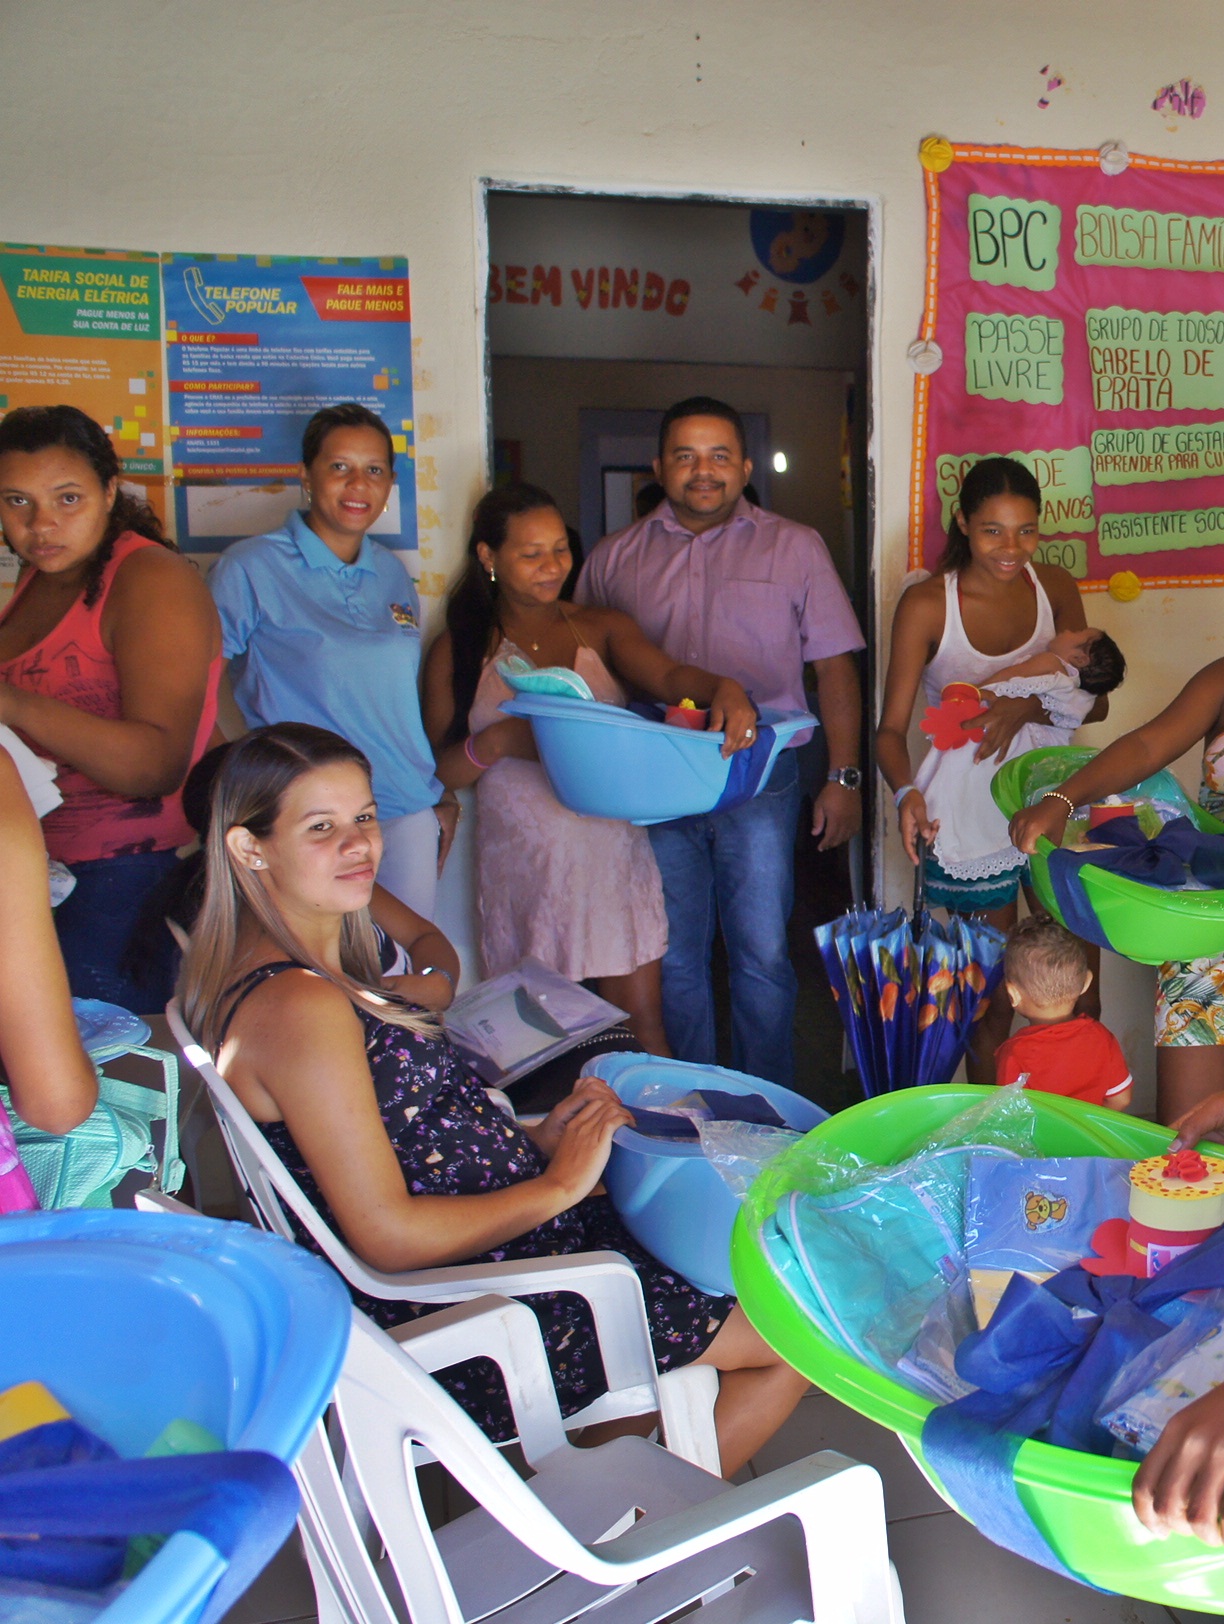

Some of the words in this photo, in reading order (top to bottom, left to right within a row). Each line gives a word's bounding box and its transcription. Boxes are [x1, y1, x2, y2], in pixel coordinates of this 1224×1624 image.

[973, 207, 1047, 271] BPC
[1080, 211, 1158, 261] BOLSA
[22, 268, 71, 284] TARIFA
[75, 271, 126, 287] SOCIAL
[129, 275, 150, 288] DE
[17, 285, 80, 302] ENERGIA
[84, 287, 150, 305] ELÉTRICA
[204, 286, 281, 300] TELEFONE
[337, 284, 364, 296] FALE
[365, 285, 394, 296] MAIS
[396, 285, 404, 296] E
[488, 265, 562, 306] BEM
[571, 266, 691, 317] VINDO
[76, 308, 104, 319] PAGUE
[105, 310, 136, 320] MENOS
[137, 311, 150, 320] NA
[225, 300, 298, 314] POPULAR
[326, 298, 362, 311] PAGUE
[364, 300, 404, 311] MENOS
[72, 320, 90, 330] SUA
[91, 321, 119, 331] CONTA
[120, 322, 132, 331] DE
[134, 323, 150, 332] LUZ
[971, 319, 1062, 356] PASSE
[1087, 316, 1142, 342] GRUPO
[1148, 318, 1169, 342] DE
[189, 334, 205, 344] QUE
[1090, 346, 1171, 377] CABELO
[1183, 349, 1215, 377] DE
[972, 358, 1052, 391] LIVRE
[183, 382, 207, 391] COMO
[208, 382, 255, 391] PARTICIPAR?
[1096, 375, 1173, 410] PRATA
[1094, 431, 1145, 454] GRUPO
[1152, 432, 1171, 454] DE
[1033, 458, 1067, 489] DE
[1095, 454, 1164, 473] APRENDER
[1168, 452, 1199, 471] PARA
[1043, 495, 1093, 525] ANOS
[1101, 512, 1188, 541] ASSISTENTE
